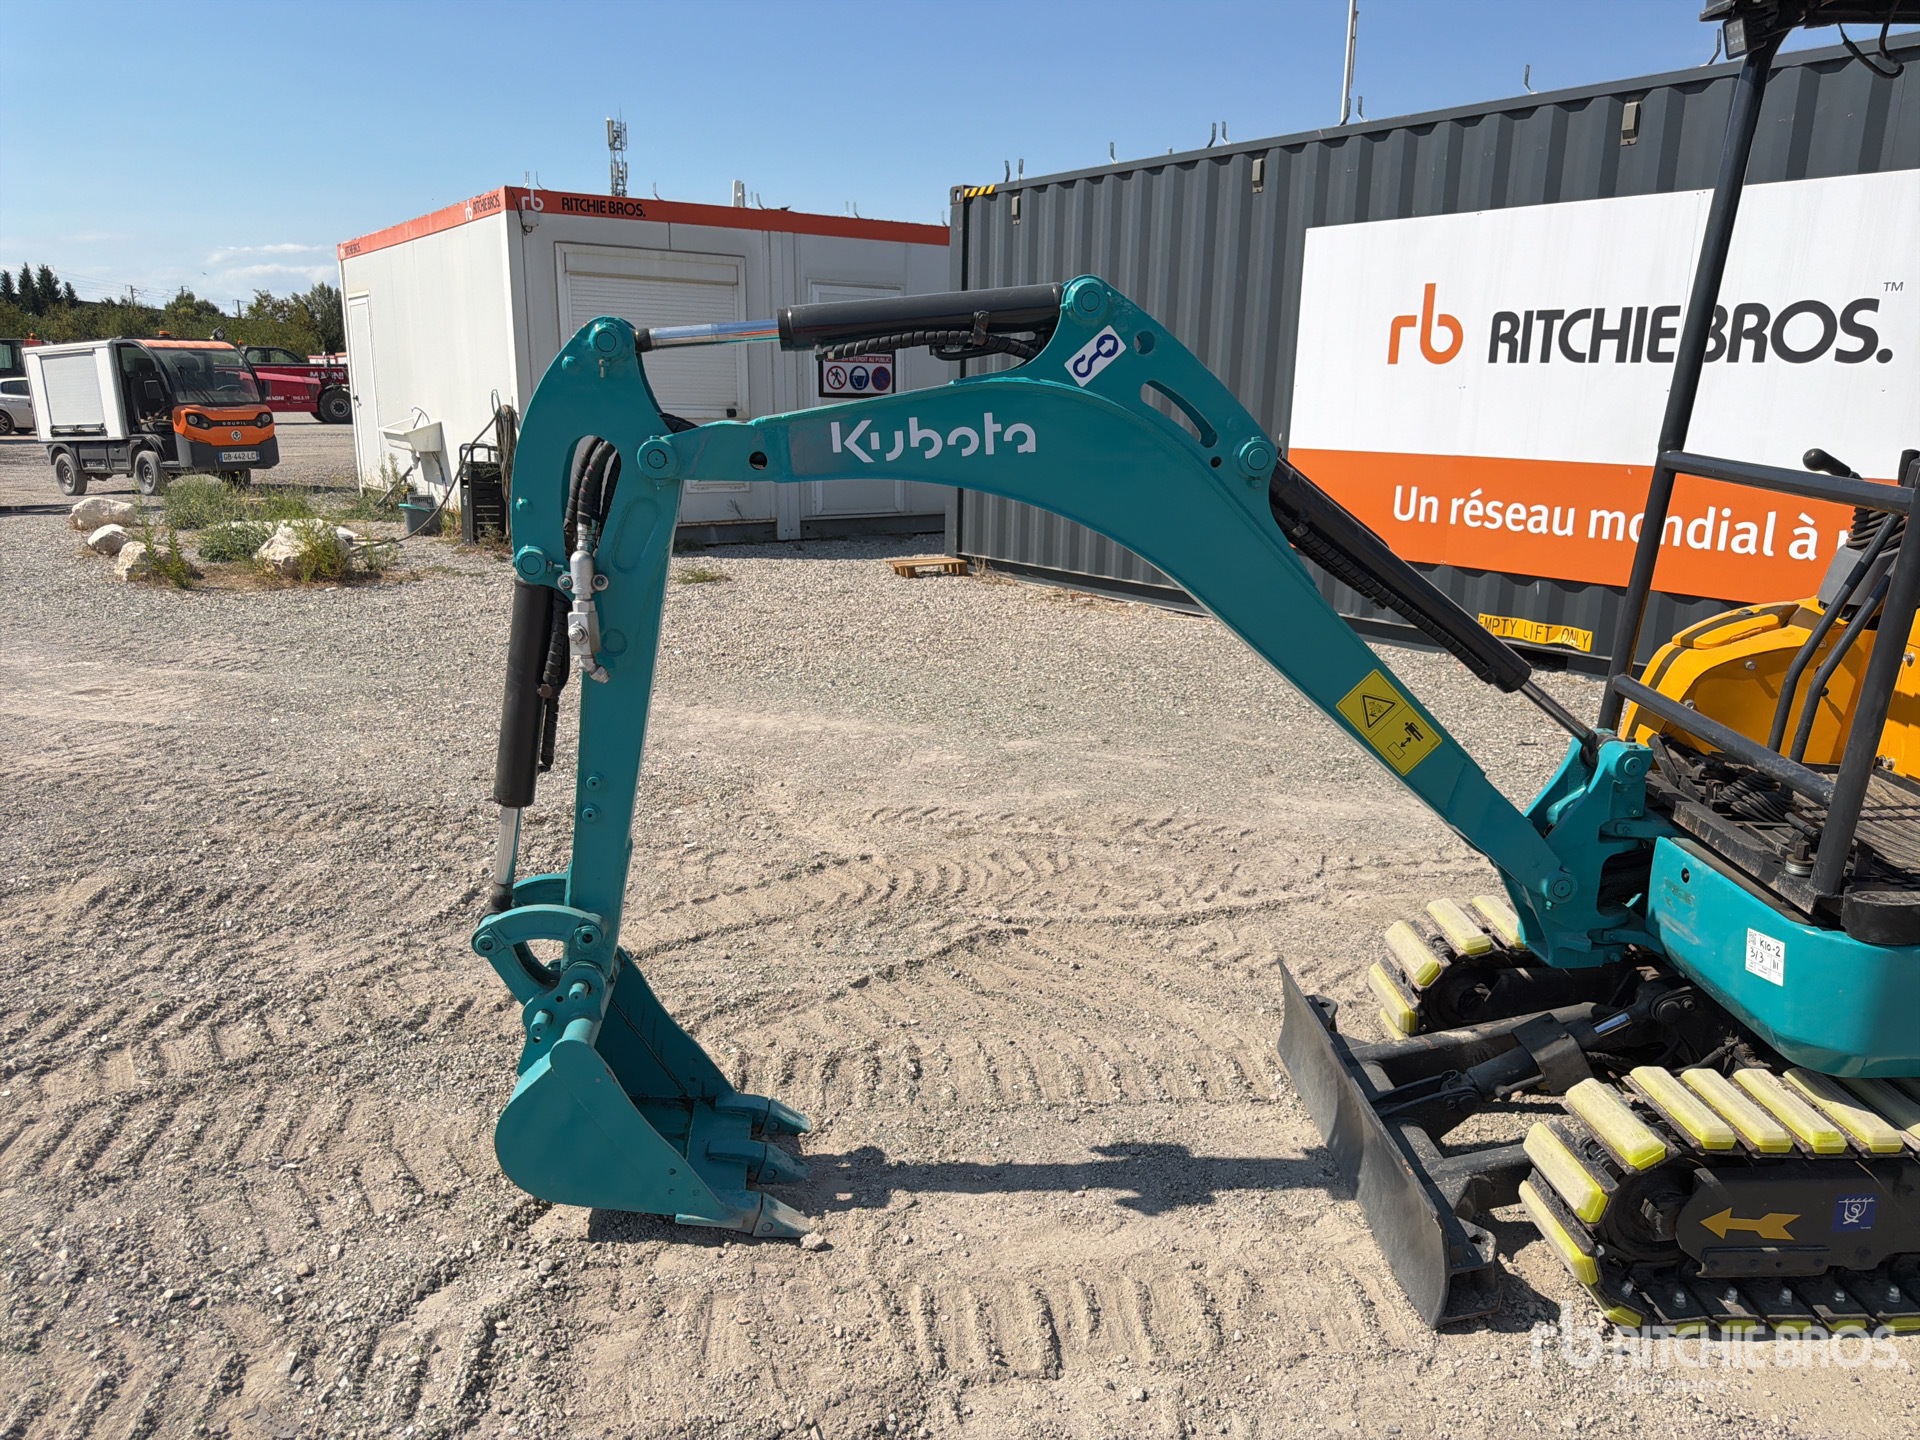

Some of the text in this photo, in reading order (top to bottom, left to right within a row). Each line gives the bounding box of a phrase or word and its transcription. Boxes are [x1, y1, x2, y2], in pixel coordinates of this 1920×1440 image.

[561, 196, 606, 214] RITCHIE
[608, 200, 647, 217] BROS.
[1387, 282, 1464, 365] rb
[1487, 304, 1682, 364] RITCHIE
[830, 412, 1037, 463] Kubota
[1393, 485, 1440, 524] Un
[1449, 487, 1575, 538] réseau
[1788, 512, 1819, 561] à
[1523, 622, 1553, 643] LIFT
[1561, 628, 1591, 649] ONLY
